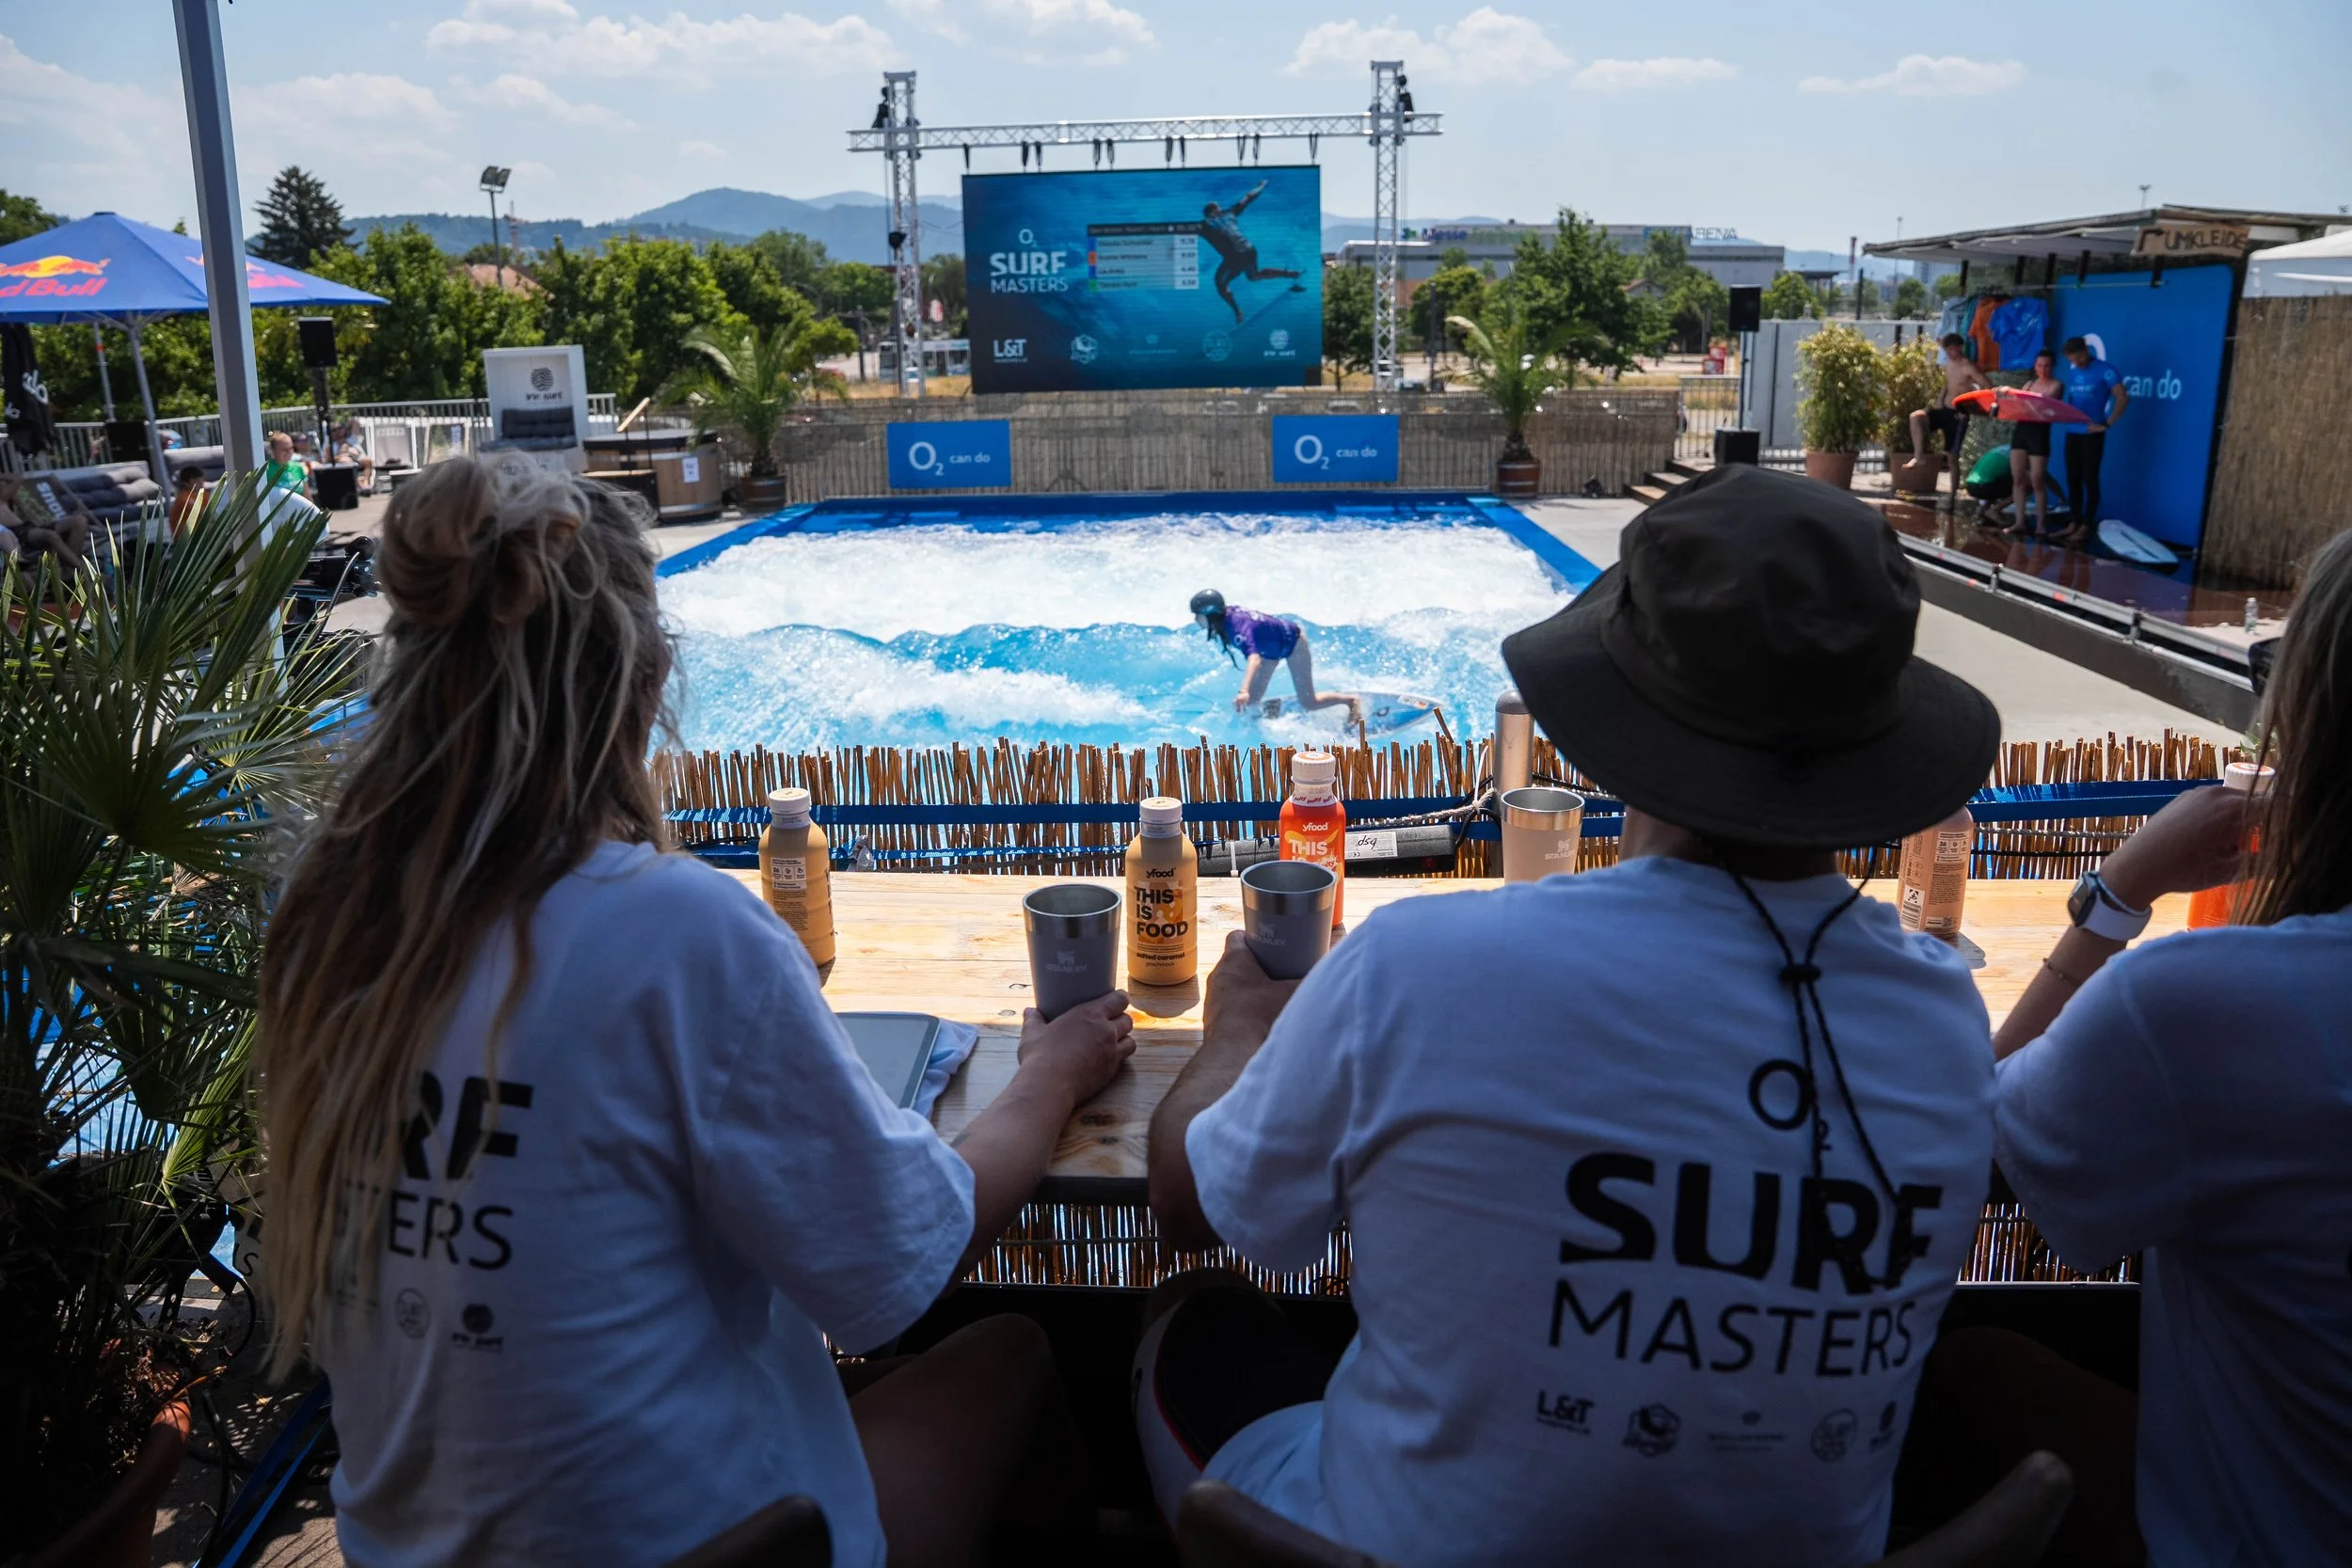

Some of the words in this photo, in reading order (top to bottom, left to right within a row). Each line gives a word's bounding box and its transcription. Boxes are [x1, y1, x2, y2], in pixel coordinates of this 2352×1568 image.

[990, 251, 1068, 277] SURF
[25, 277, 108, 297] Bull
[991, 277, 1070, 293] MASTERS
[993, 339, 1027, 358] L&T
[2156, 369, 2182, 400] do
[909, 441, 945, 476] O2
[949, 453, 973, 465] can
[975, 451, 991, 464] do
[1295, 435, 1330, 470] O2
[1336, 449, 1360, 459] can
[1361, 446, 1377, 458] do
[1302, 822, 1329, 832] yfood
[1289, 839, 1328, 856] THIS
[1145, 868, 1174, 879] yfood
[1134, 886, 1174, 904] THIS
[1136, 904, 1152, 921] IS
[1136, 921, 1188, 938] FOOD
[1136, 952, 1157, 960] salted
[1157, 951, 1185, 961] caramel
[1559, 1152, 1943, 1295] SURF
[1548, 1279, 1916, 1377] MASTERS
[1536, 1389, 1596, 1425] L&T
